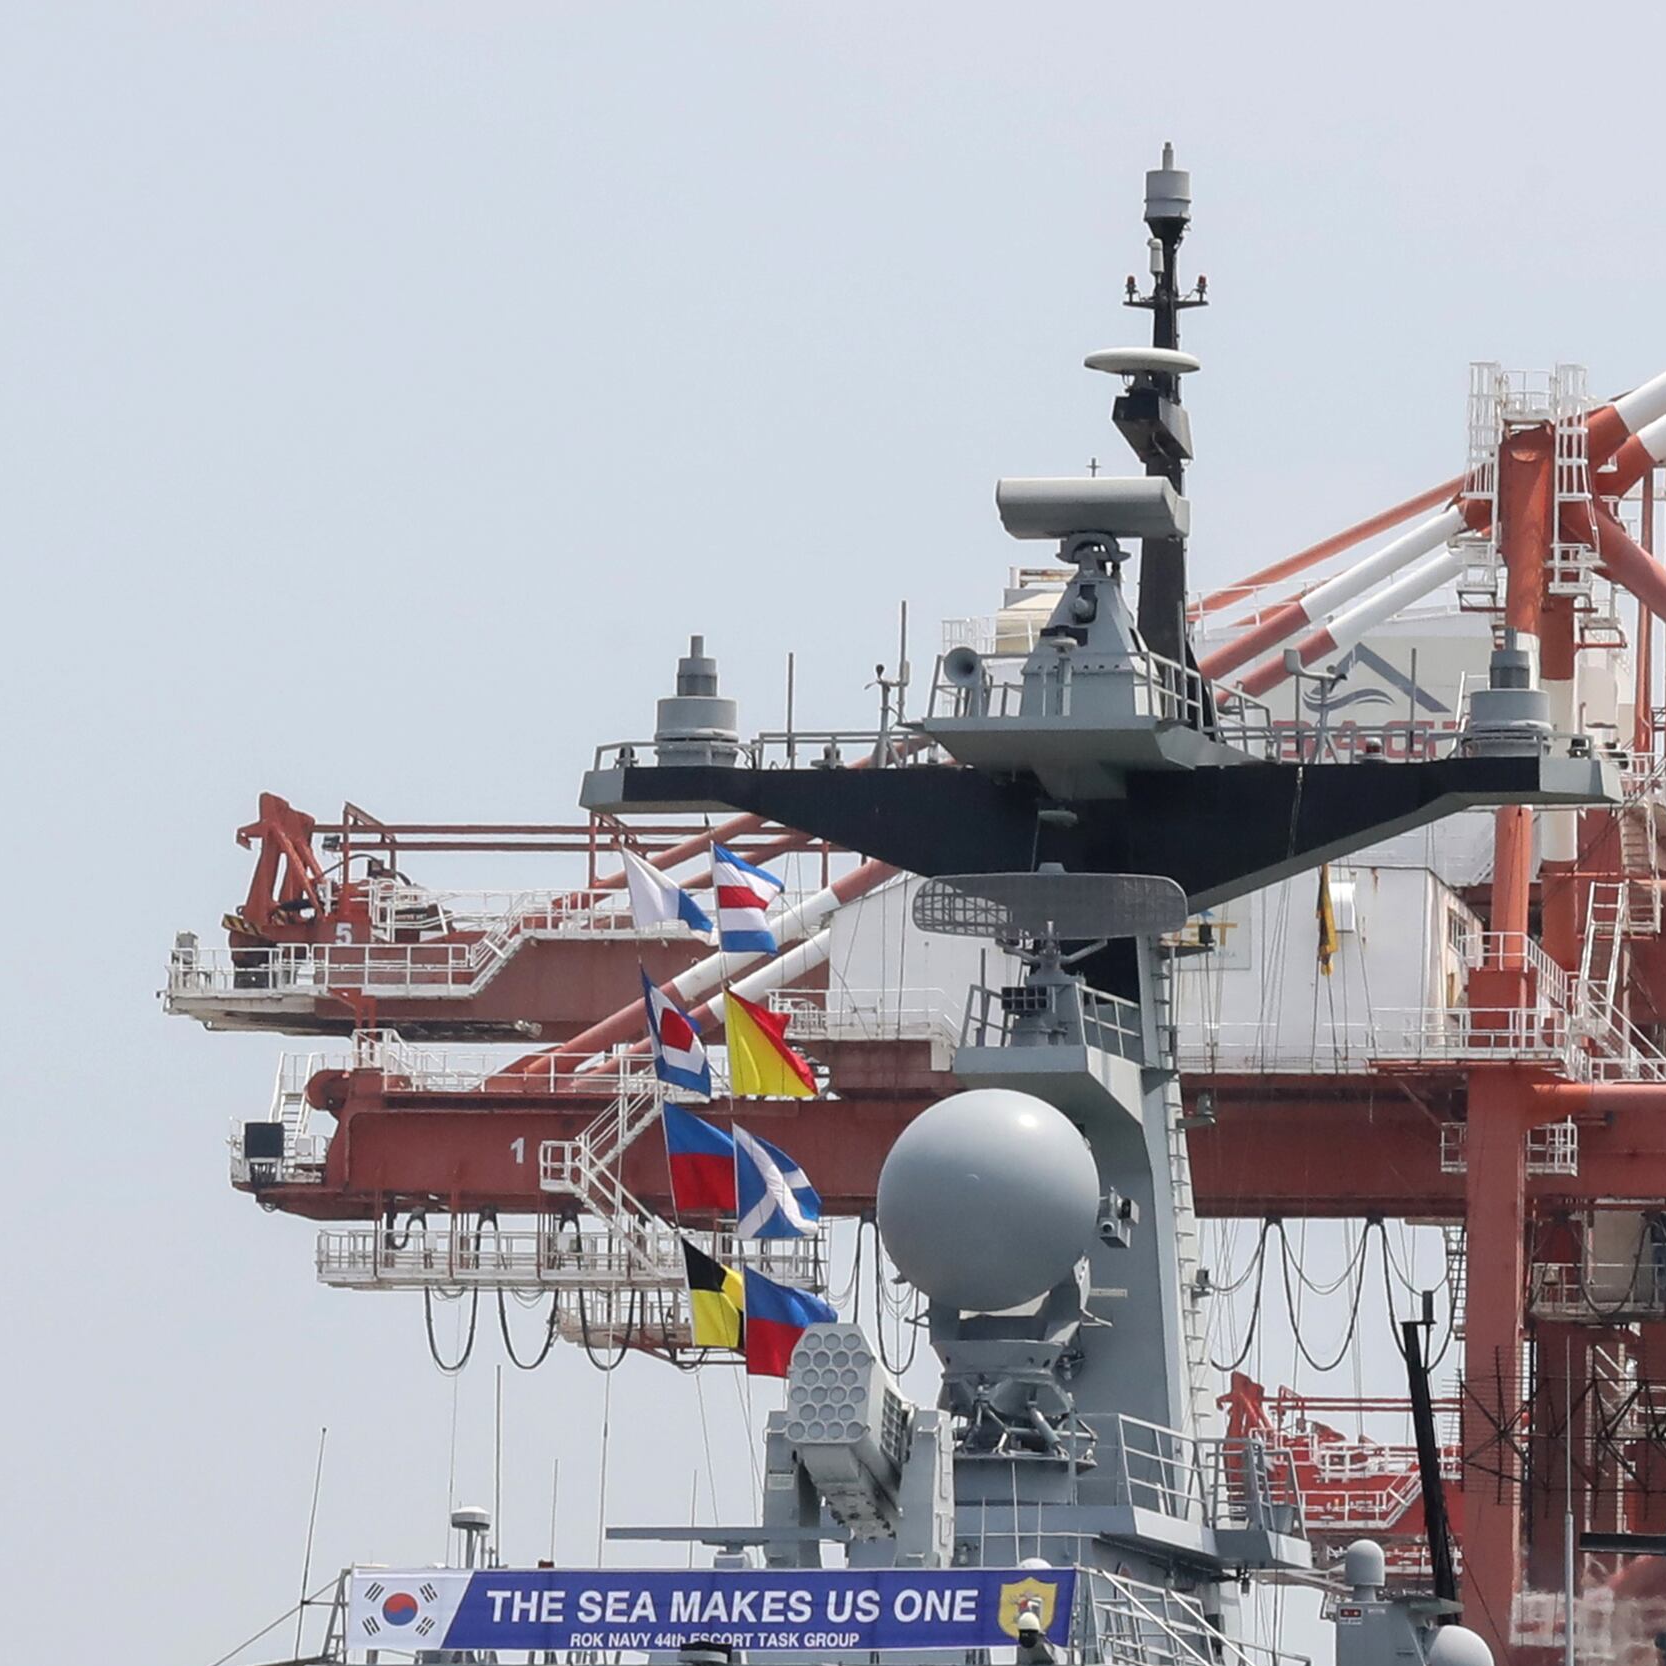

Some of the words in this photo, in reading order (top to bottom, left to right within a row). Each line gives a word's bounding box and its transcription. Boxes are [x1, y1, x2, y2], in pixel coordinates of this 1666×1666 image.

[336, 923, 353, 945] 5
[511, 1137, 526, 1165] 1
[486, 1590, 566, 1623] THE
[577, 1590, 658, 1624] SEA
[669, 1590, 813, 1624] MAKES
[826, 1590, 881, 1623] US
[893, 1588, 979, 1622] ONE
[570, 1633, 603, 1648] ROK
[608, 1633, 652, 1648] NAVY
[654, 1632, 687, 1648] 44th
[758, 1632, 799, 1647] TASK
[804, 1632, 860, 1647] GROUP
